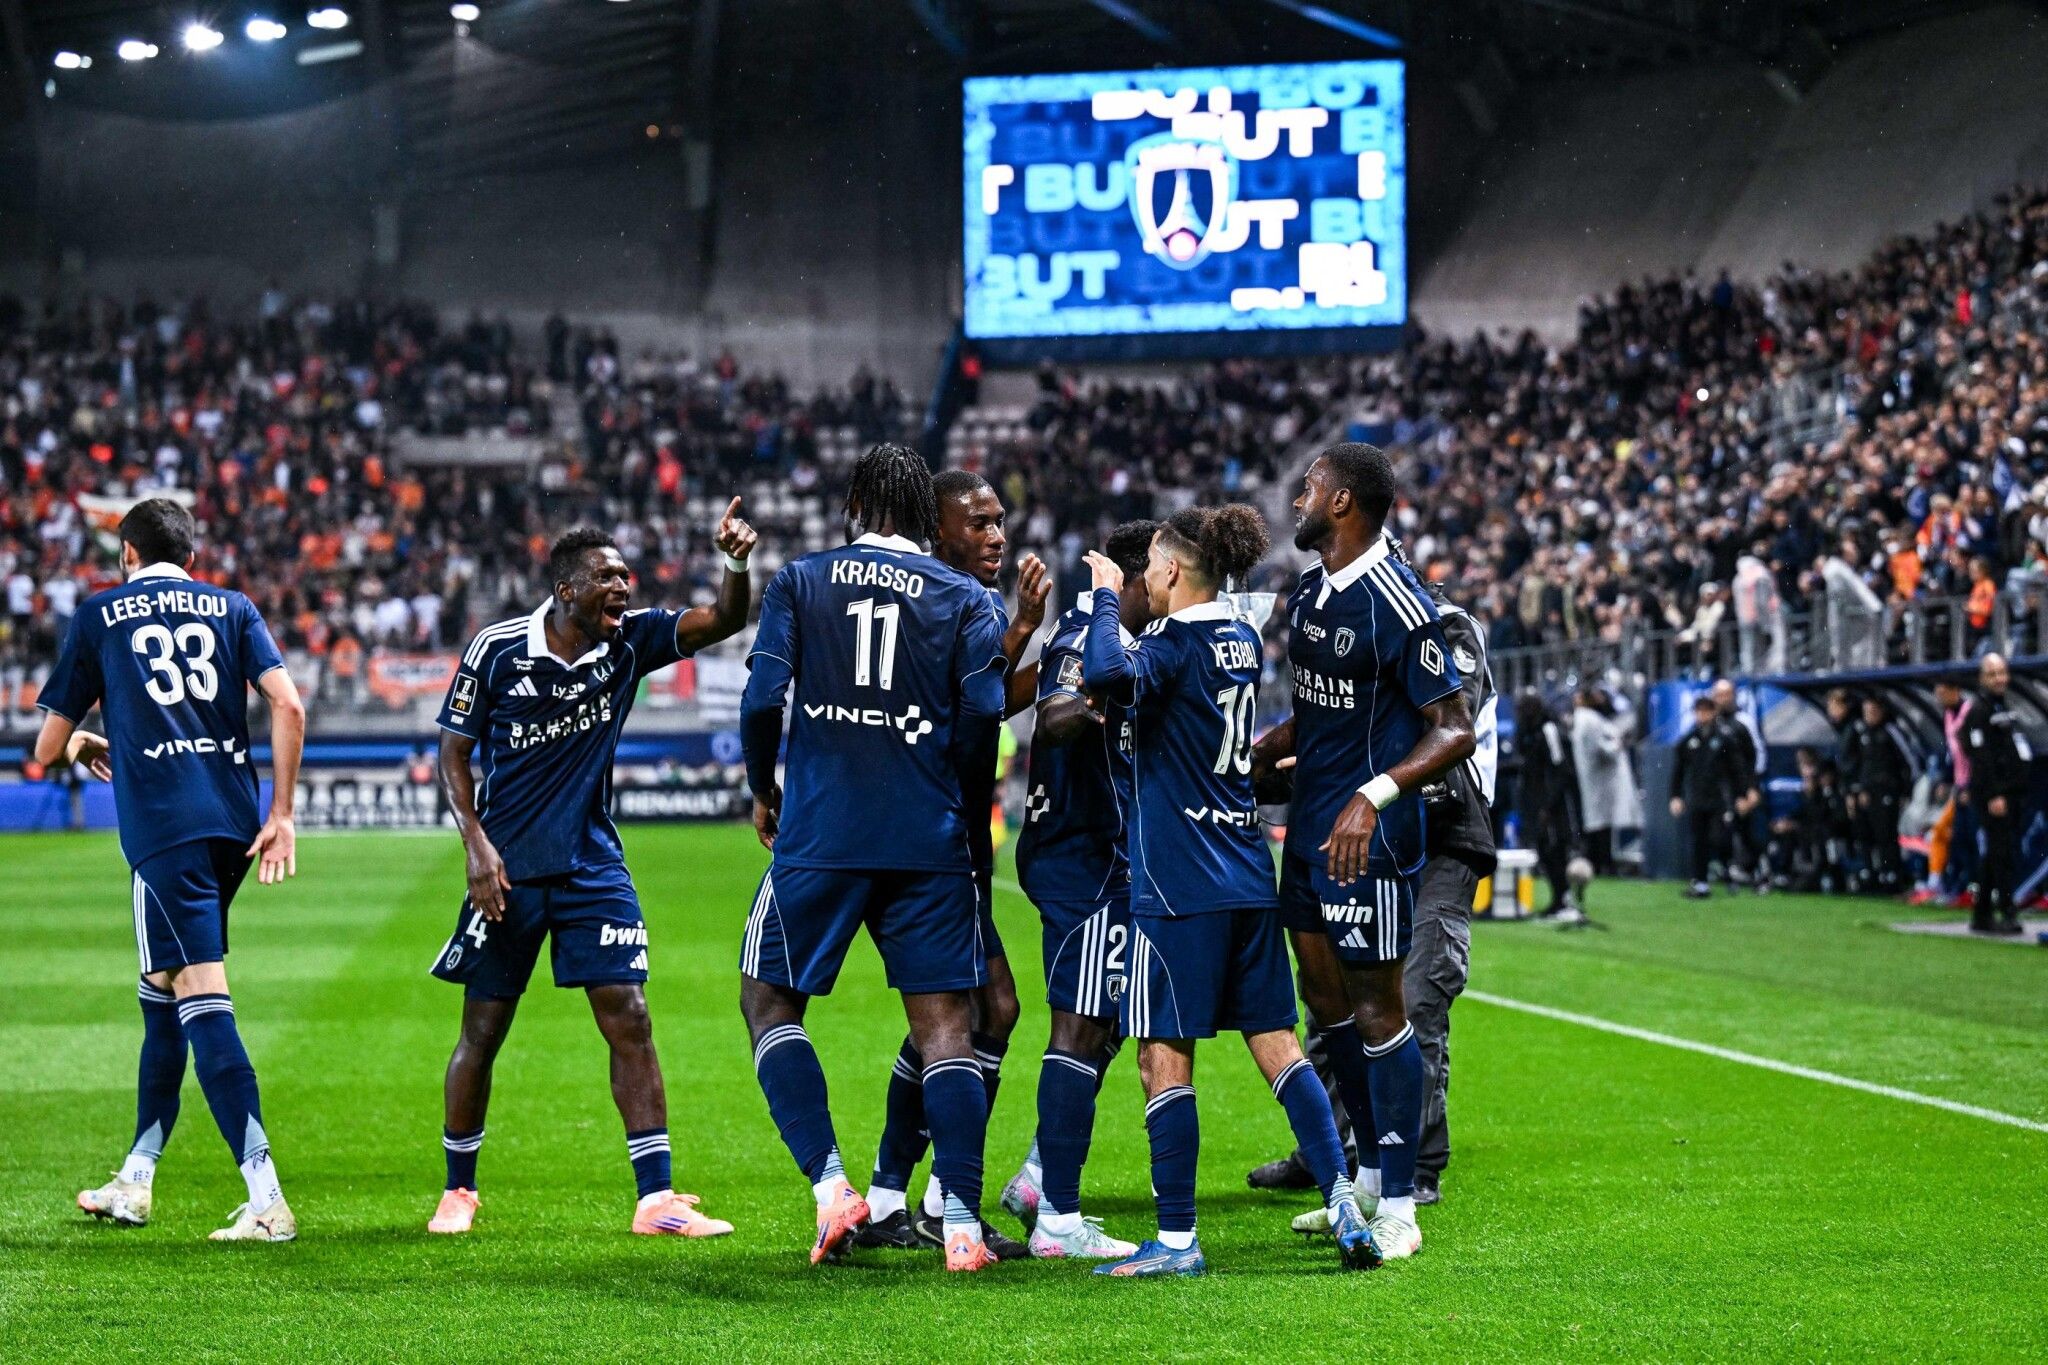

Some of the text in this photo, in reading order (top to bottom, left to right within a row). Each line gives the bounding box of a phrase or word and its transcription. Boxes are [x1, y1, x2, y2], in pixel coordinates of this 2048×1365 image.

[831, 559, 924, 599] KRASSO
[101, 590, 228, 628] LEES-MELOU
[1303, 619, 1321, 638] Lyca
[846, 597, 900, 691] 11
[131, 622, 219, 706] 33
[512, 657, 535, 666] Google
[552, 684, 578, 699] Lya
[1292, 663, 1354, 695] HRAIN
[1293, 681, 1355, 709] TORIOUS
[803, 703, 891, 727] VINCI
[1213, 683, 1257, 775] 10
[143, 737, 220, 759] VINC
[1320, 897, 1373, 924] win
